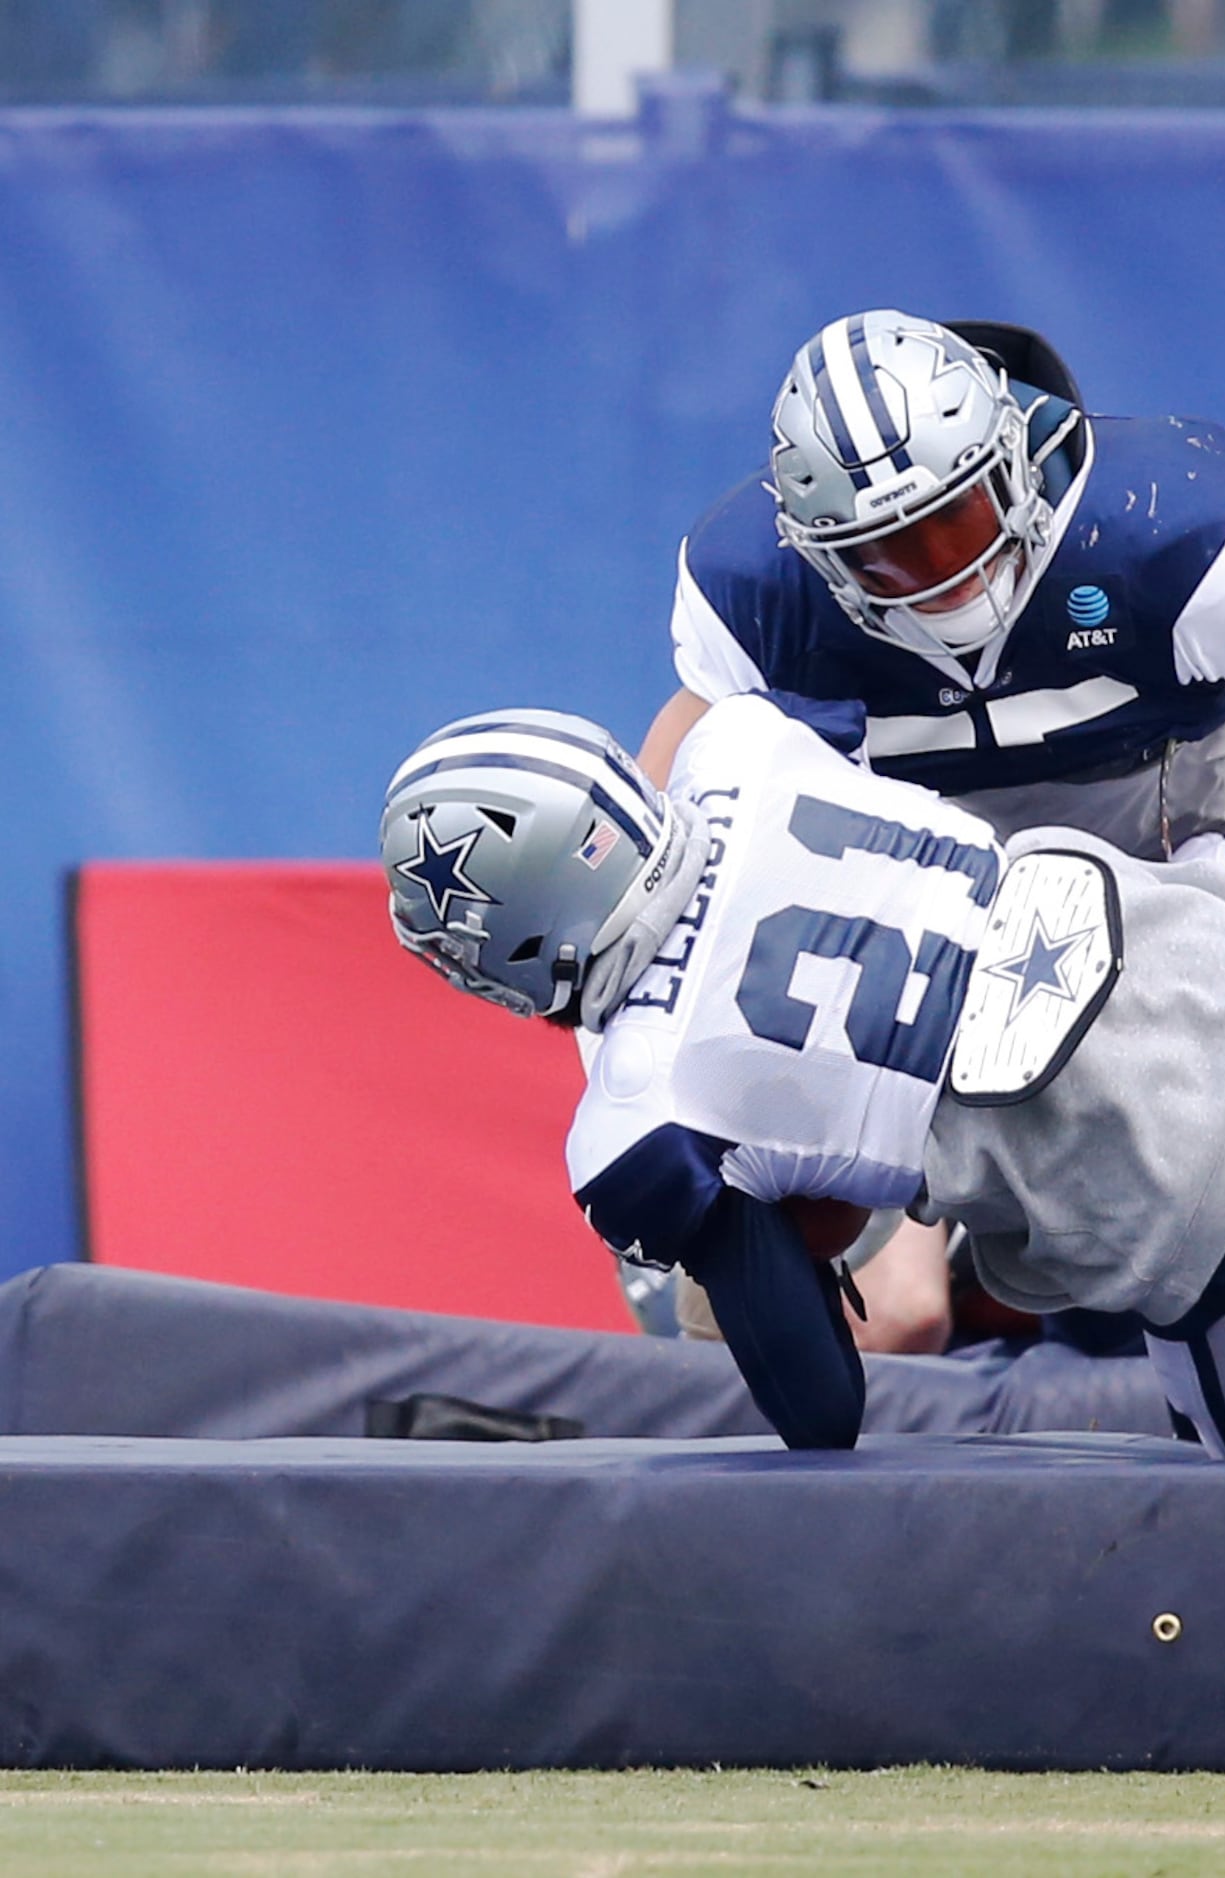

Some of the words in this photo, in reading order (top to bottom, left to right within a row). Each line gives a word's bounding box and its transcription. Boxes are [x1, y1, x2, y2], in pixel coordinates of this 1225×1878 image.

[1067, 628, 1117, 650] AT&T
[623, 787, 740, 1014] ELLT
[734, 794, 1001, 1085] 21
